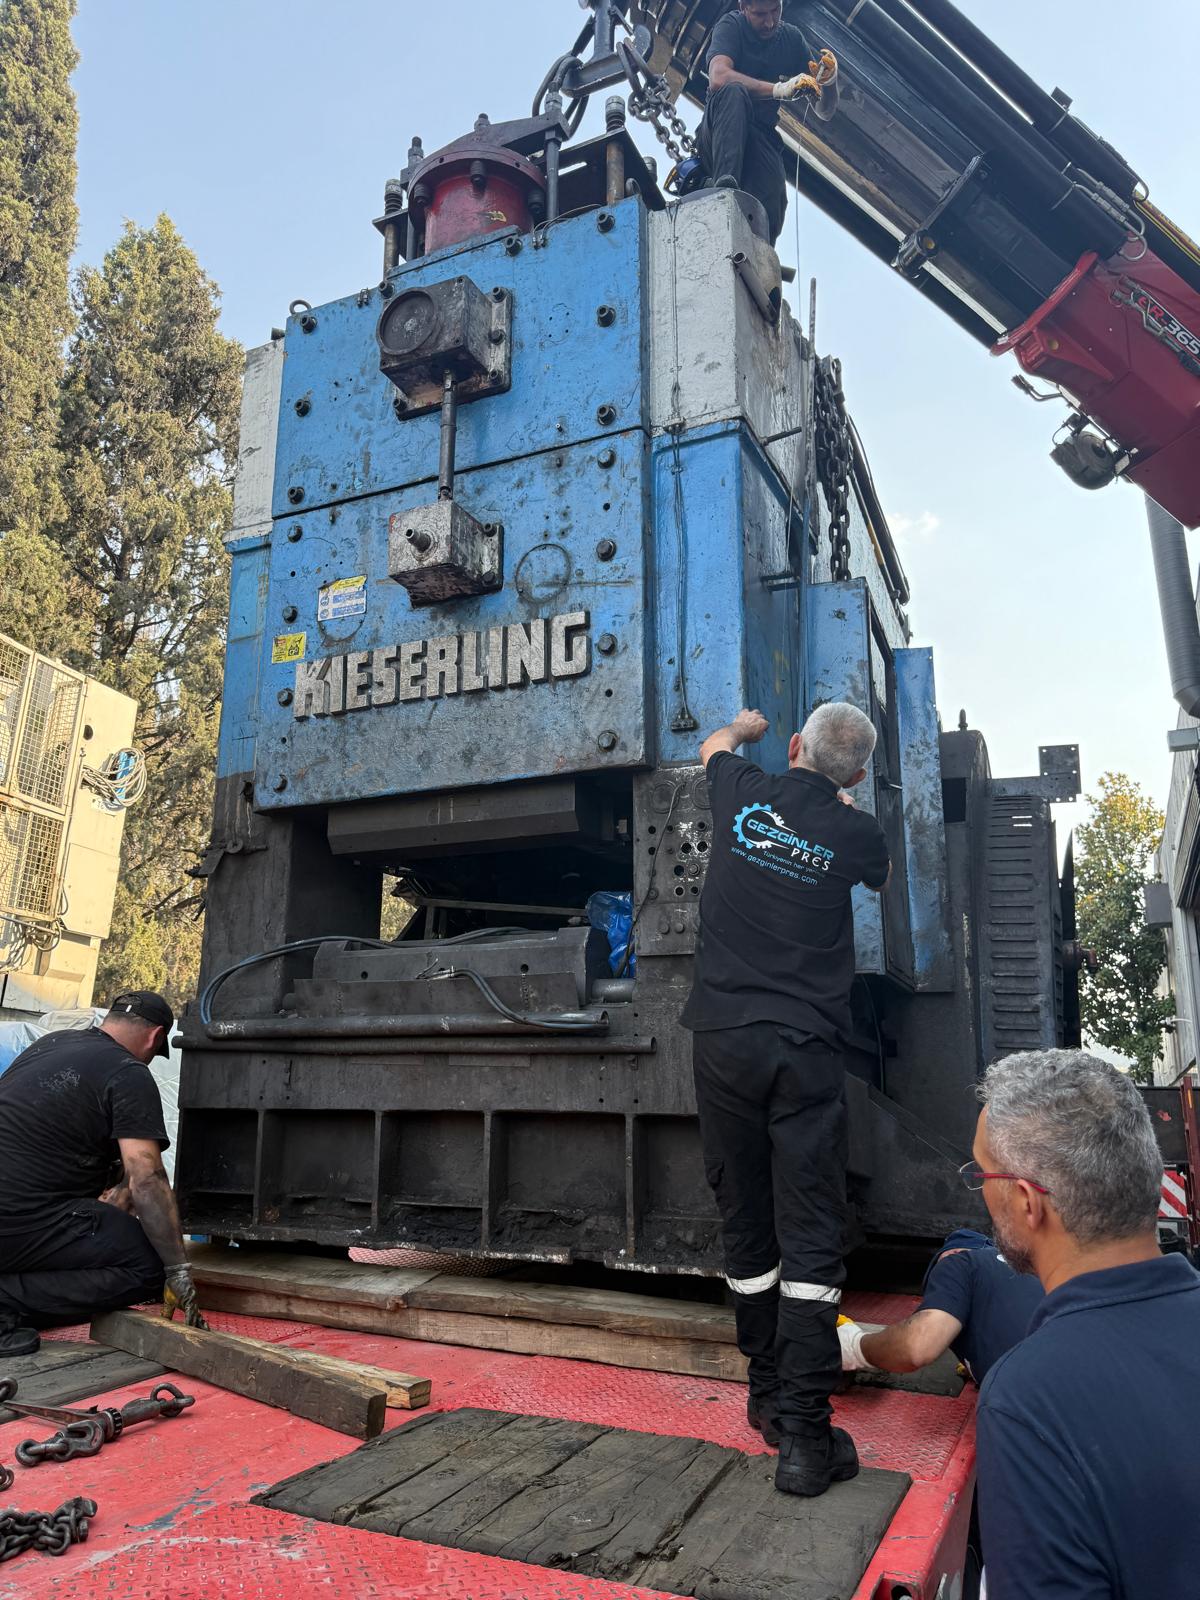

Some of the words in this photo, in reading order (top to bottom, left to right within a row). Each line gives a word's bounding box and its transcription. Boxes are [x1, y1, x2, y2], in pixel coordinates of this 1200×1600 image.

[293, 610, 590, 720] KIESERLING
[746, 818, 835, 860] GEZGİNLER
[790, 847, 831, 871] PRES
